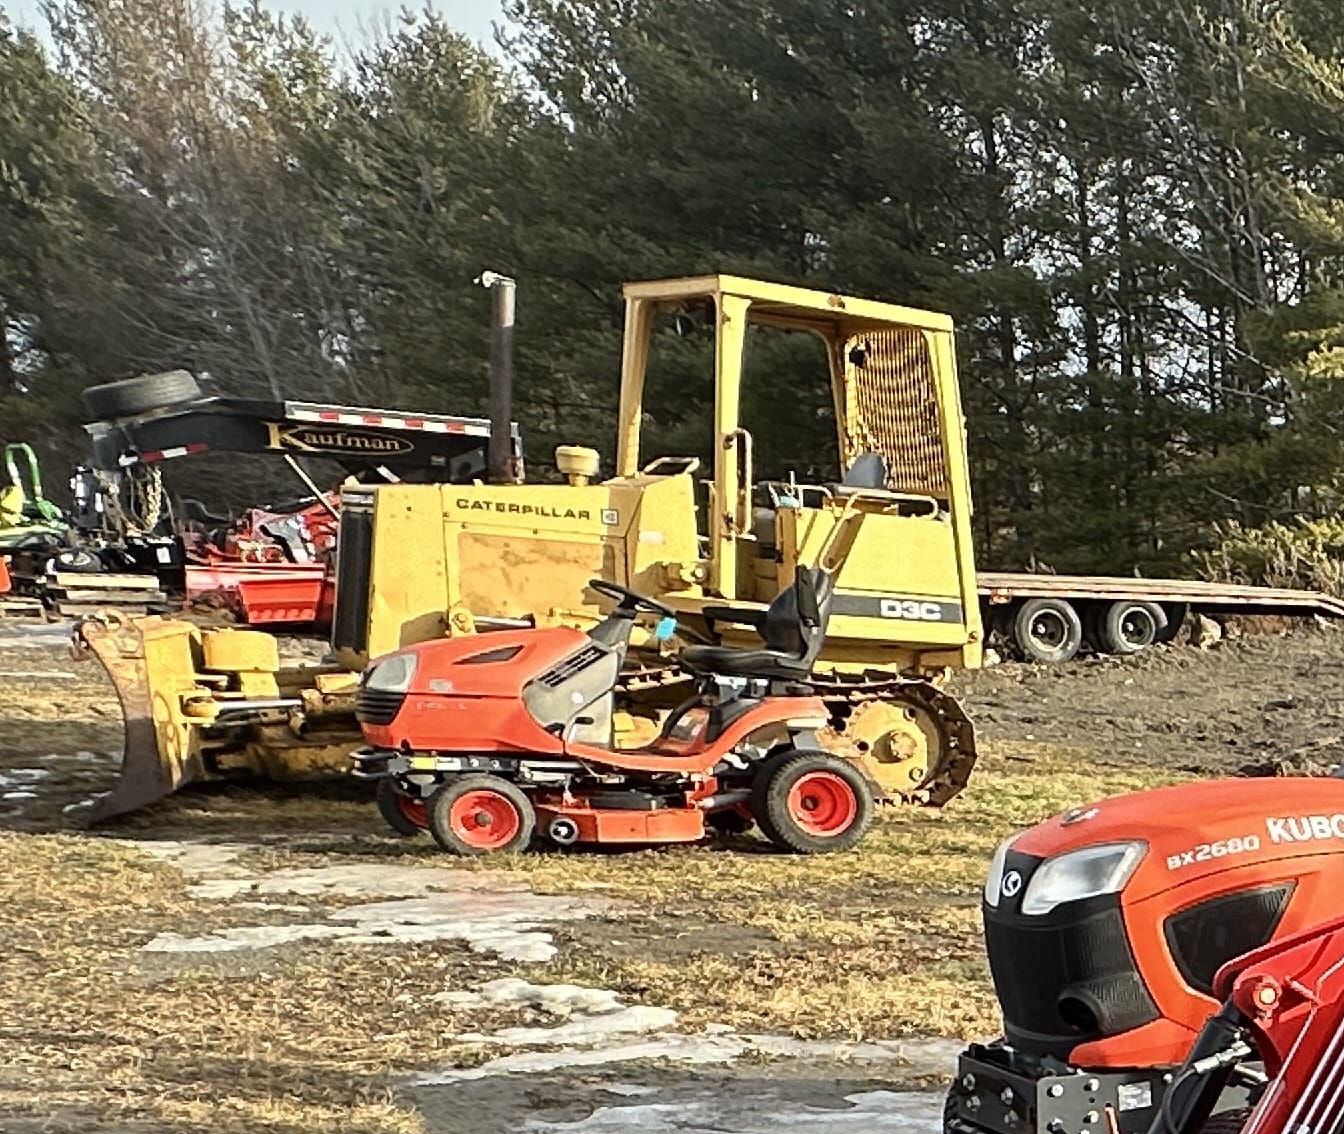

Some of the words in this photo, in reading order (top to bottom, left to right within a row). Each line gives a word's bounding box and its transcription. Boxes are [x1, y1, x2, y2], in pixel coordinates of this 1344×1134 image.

[268, 421, 402, 455] Kaufman
[455, 498, 592, 521] CATERPILLAR
[880, 599, 942, 620] D3C
[1166, 834, 1260, 871] BX2680
